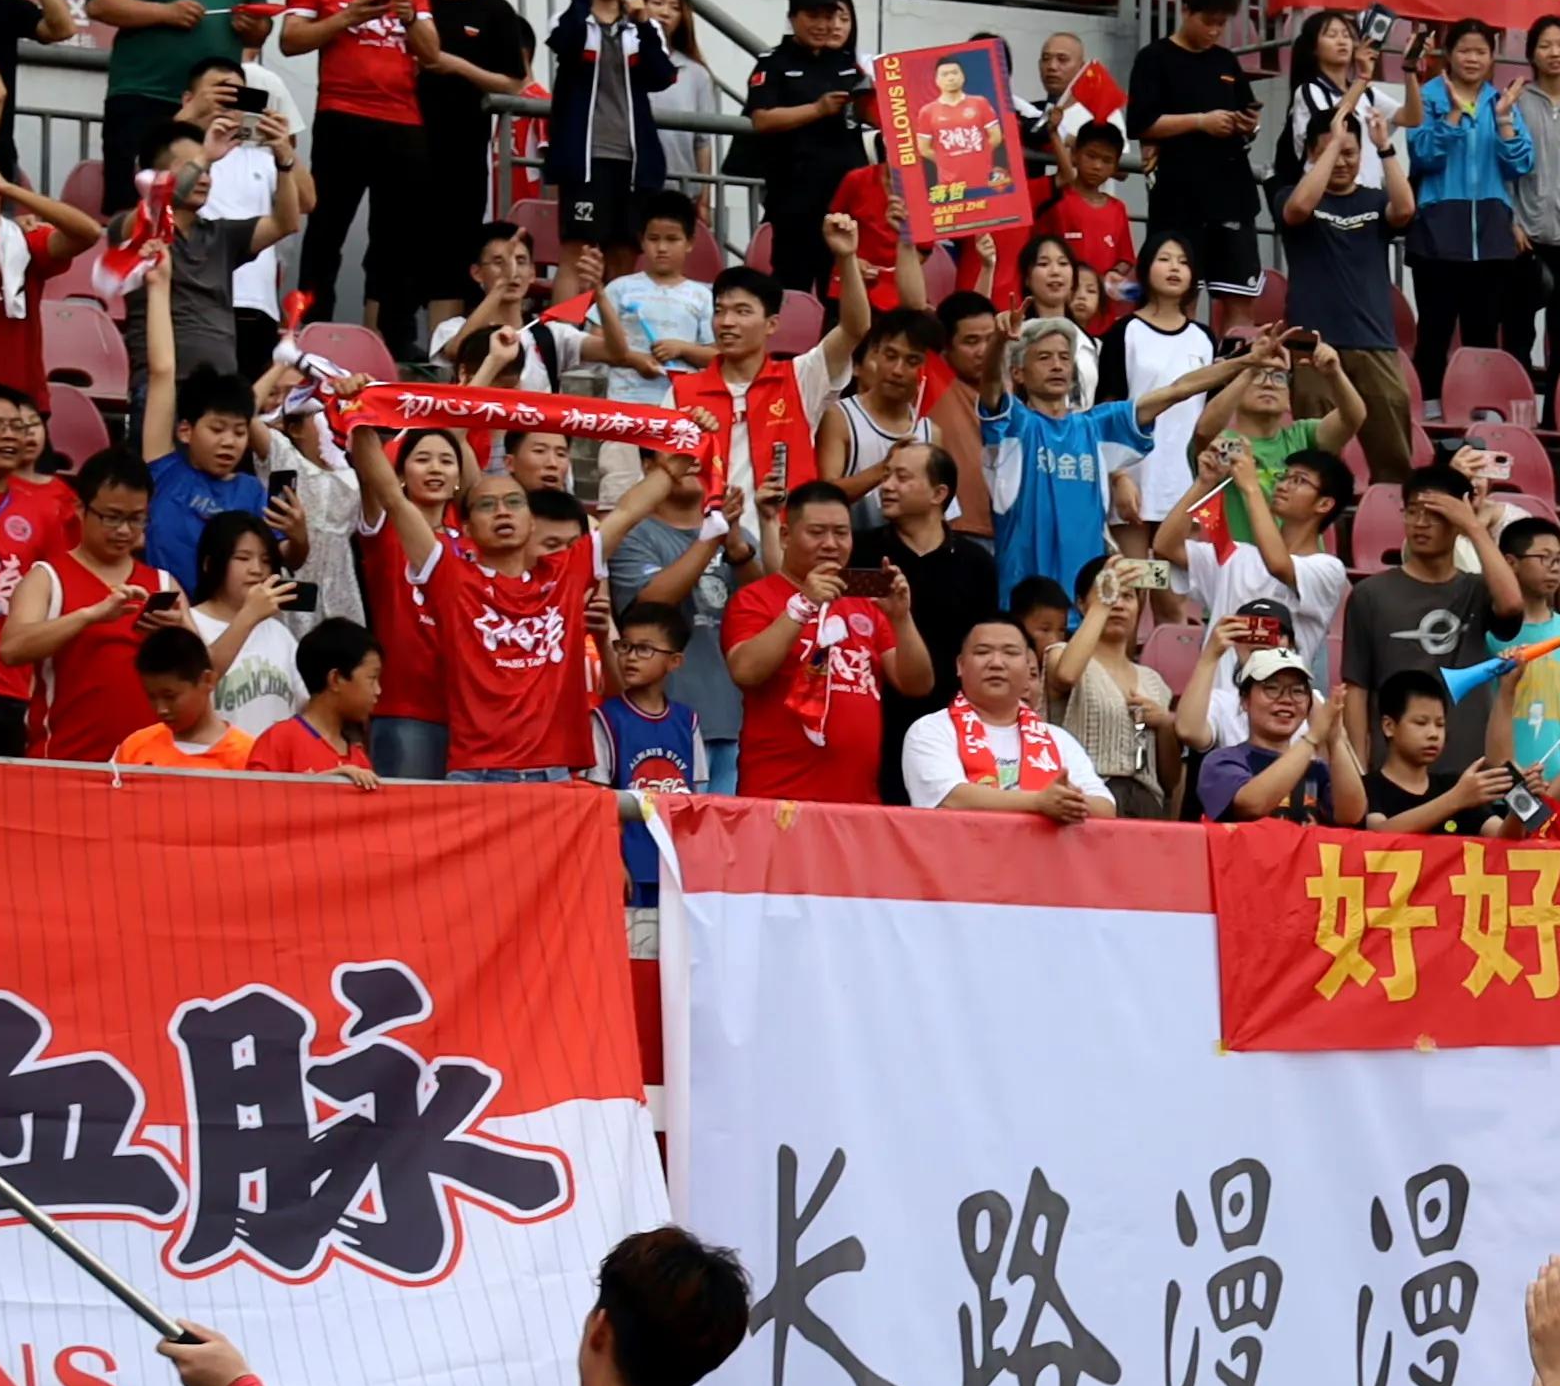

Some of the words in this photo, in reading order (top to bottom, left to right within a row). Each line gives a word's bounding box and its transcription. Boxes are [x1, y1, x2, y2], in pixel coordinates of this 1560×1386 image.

[888, 85, 917, 167] BILLOWS
[395, 391, 545, 428] 初心不忘
